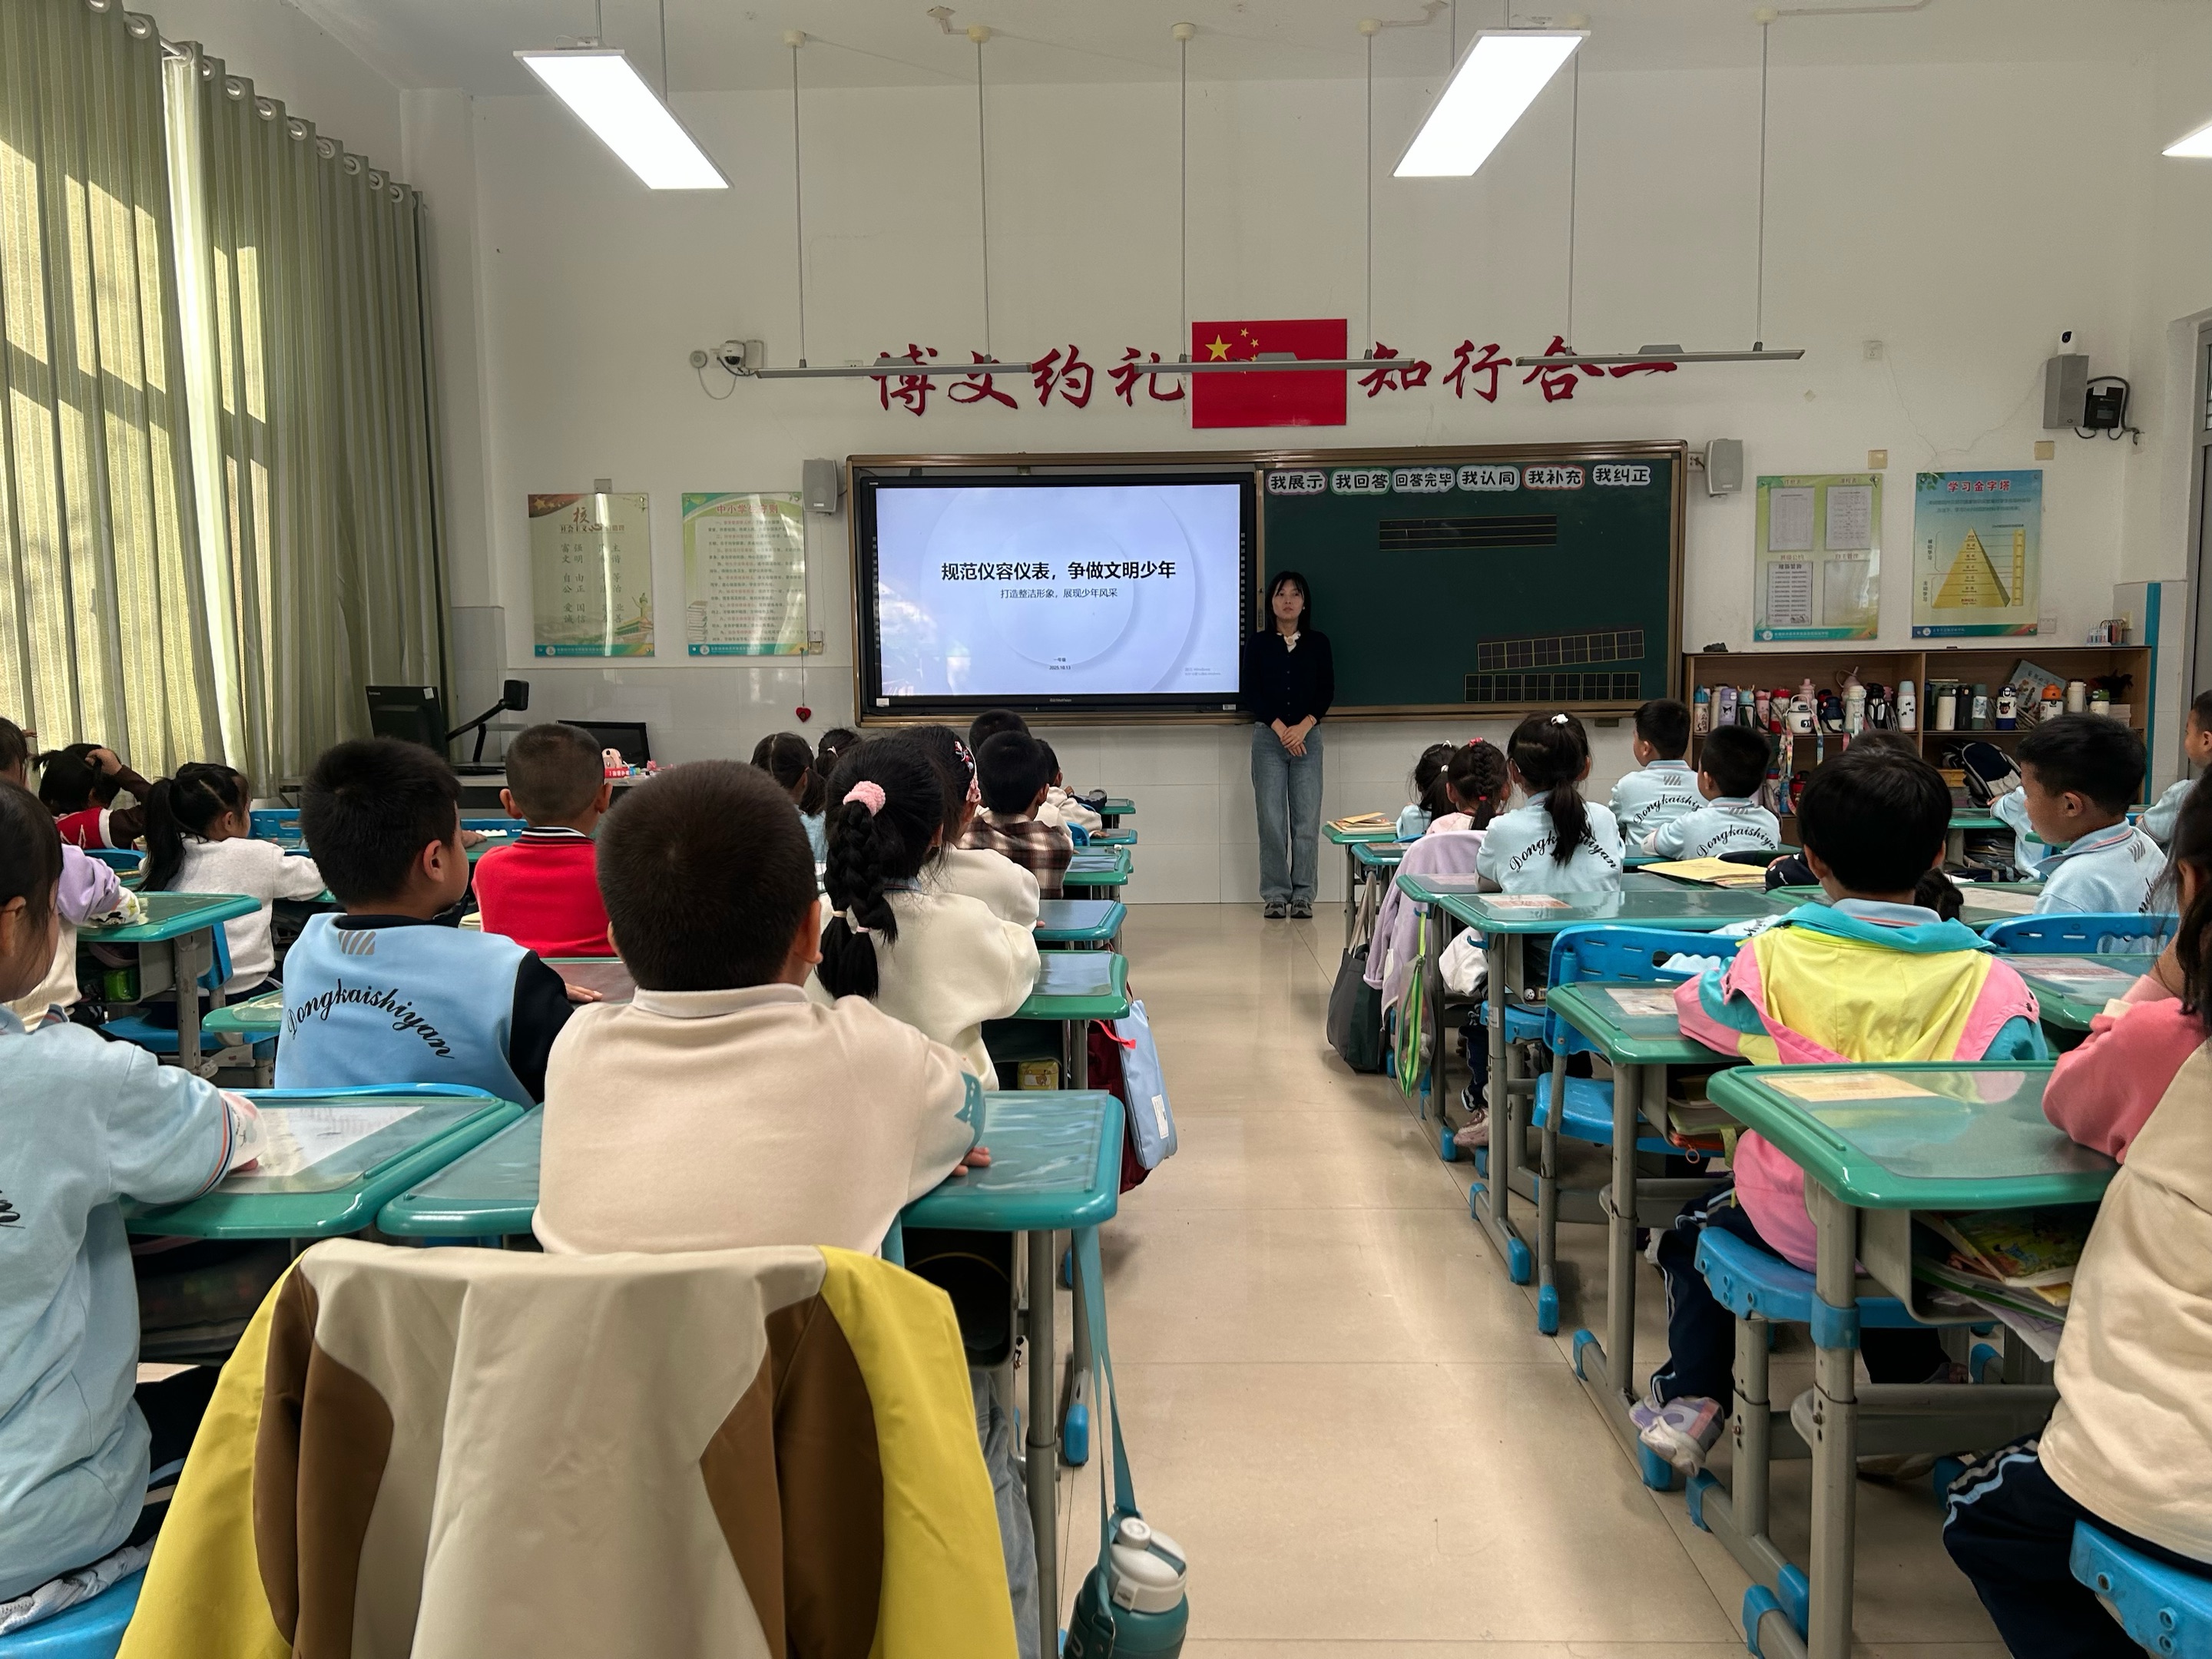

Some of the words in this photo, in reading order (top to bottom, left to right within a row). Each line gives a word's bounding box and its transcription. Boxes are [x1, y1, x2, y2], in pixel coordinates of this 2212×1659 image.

[1358, 335, 1678, 402] 知行合一
[869, 343, 1185, 416] 博文约礼
[1270, 475, 1323, 490] 我展示
[1336, 474, 1389, 489] 我回答
[1396, 473, 1452, 487] 回答完毕
[1462, 471, 1515, 485] 我认同
[1528, 469, 1581, 485] 我补充
[1595, 468, 1648, 482] 我纠正
[1947, 480, 2011, 492] 学习金字塔
[941, 561, 1177, 581] 规范仪容仪表，争做文明少年
[1000, 588, 1118, 598] 打造整洁形象，展现少年风采
[1696, 824, 1777, 857] Dongkaishiya
[286, 978, 455, 1059] Dongkaishiyan
